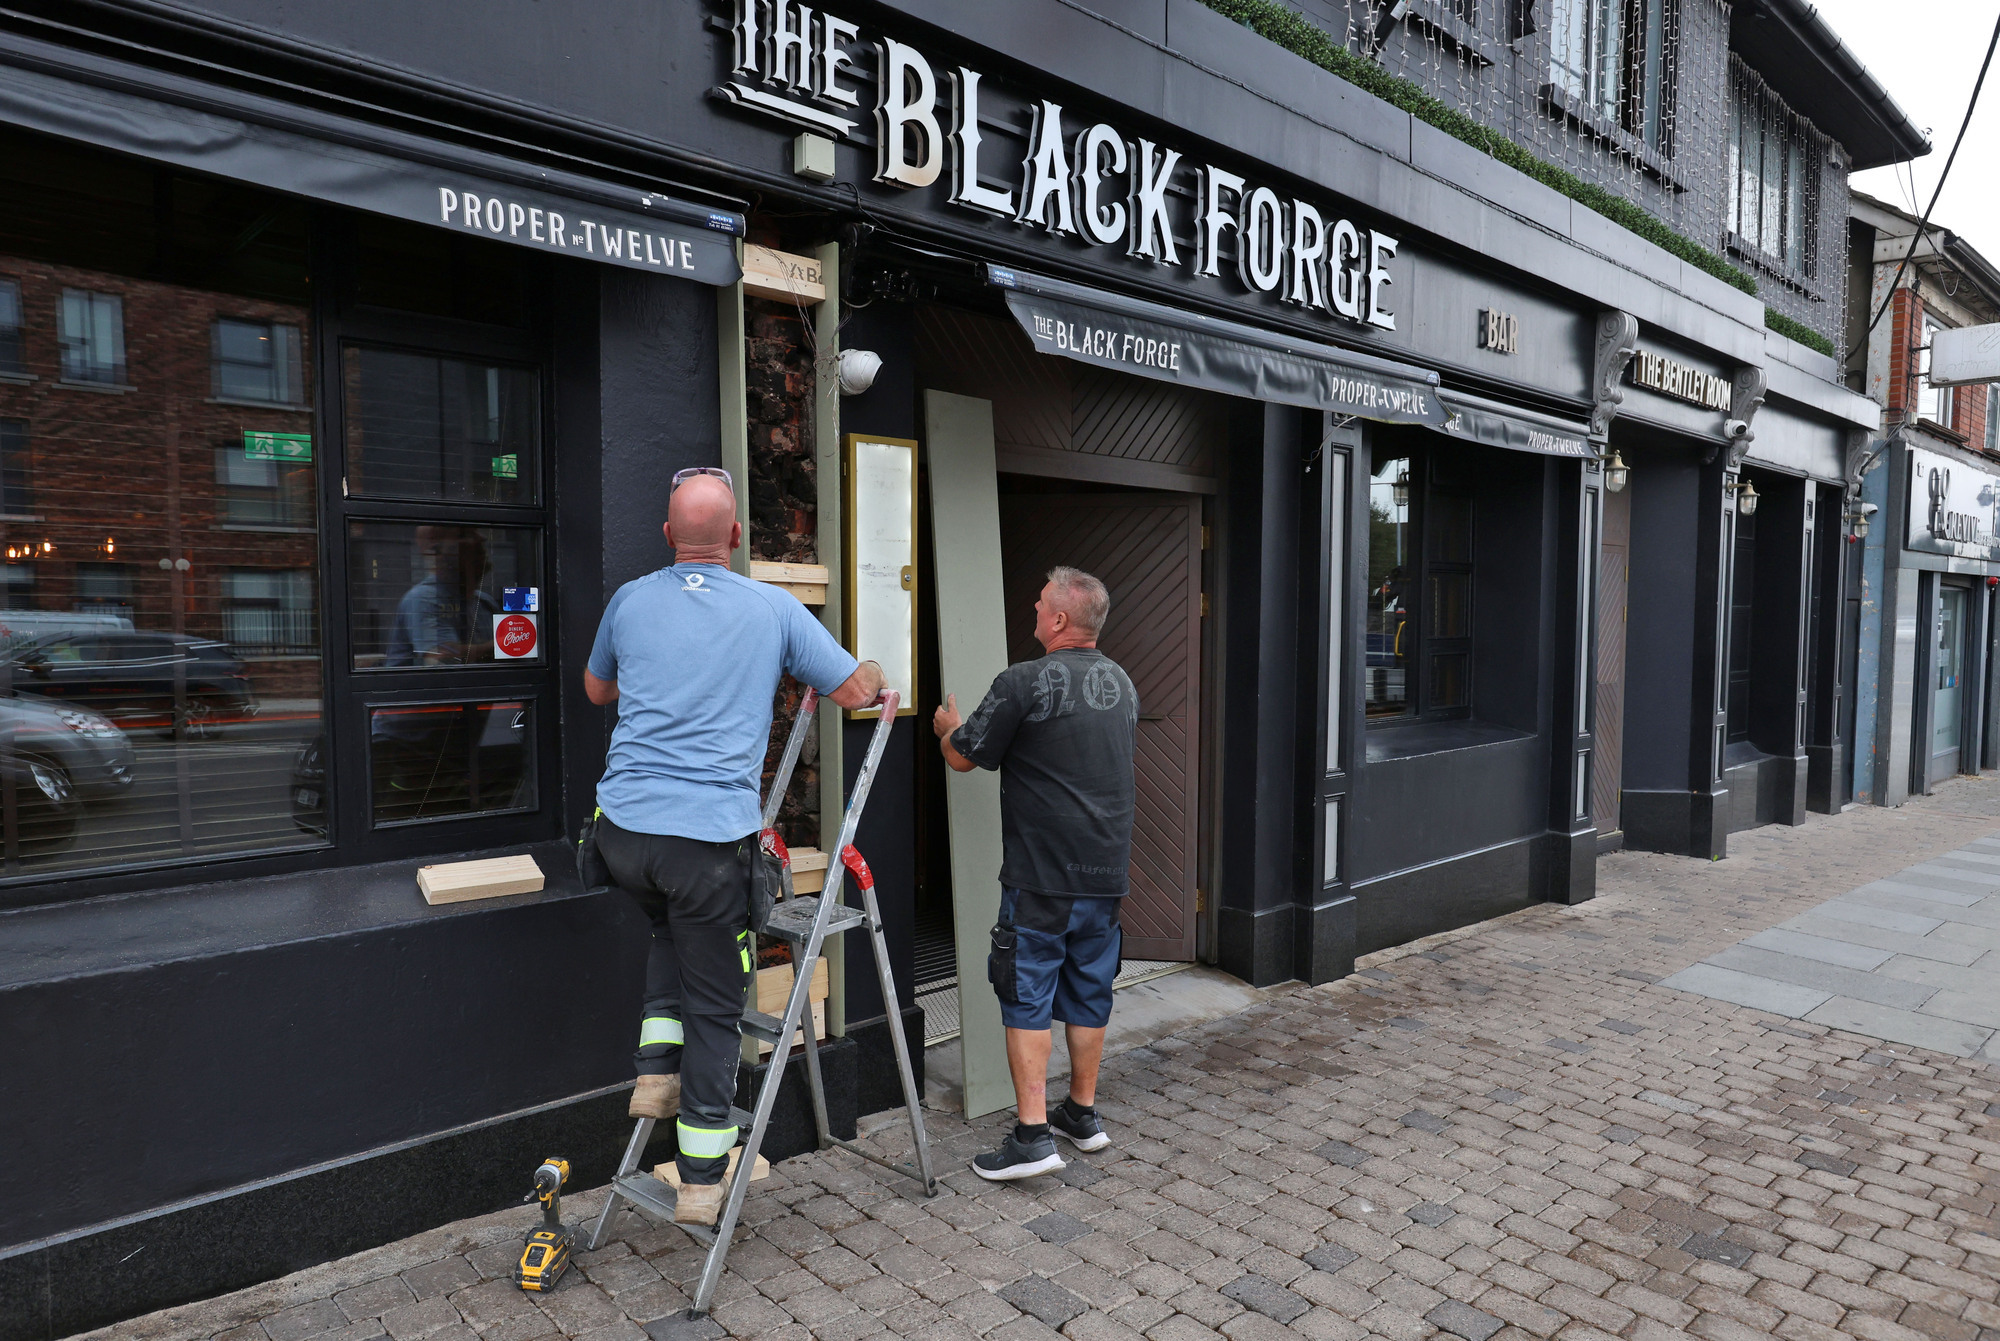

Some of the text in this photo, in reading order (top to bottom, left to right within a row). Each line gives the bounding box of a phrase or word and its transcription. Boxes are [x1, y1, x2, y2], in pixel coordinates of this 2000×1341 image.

[873, 36, 1183, 266] BLACK
[1196, 165, 1397, 332] FORGE
[439, 187, 566, 248] PROPER
[580, 220, 695, 271] TWELVE
[1034, 315, 1181, 371] THE BLACK FORGE
[1487, 306, 1519, 356] BAR
[1331, 376, 1377, 408] PROPER
[1381, 388, 1429, 416] TWELVE
[1640, 350, 1732, 412] THE BENTLEY ROOM
[1527, 430, 1585, 456] PROPER TWELVE
[503, 631, 530, 647] Choice
